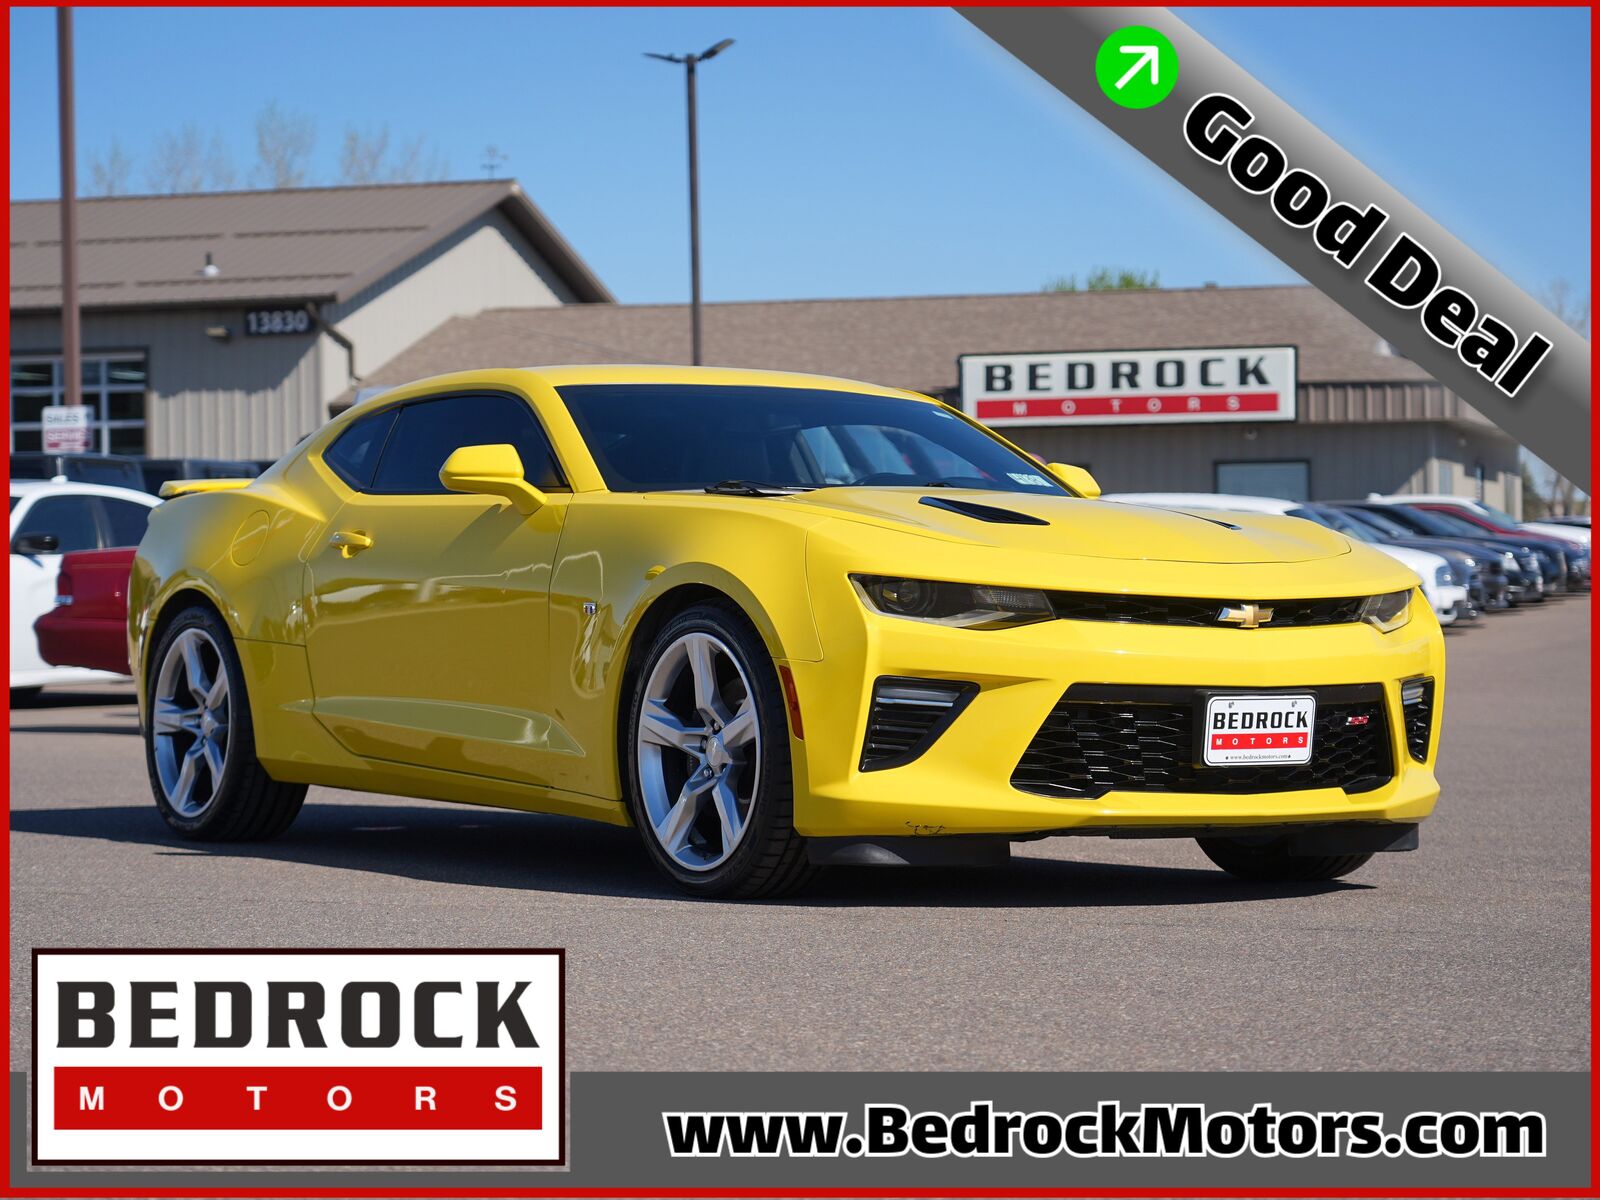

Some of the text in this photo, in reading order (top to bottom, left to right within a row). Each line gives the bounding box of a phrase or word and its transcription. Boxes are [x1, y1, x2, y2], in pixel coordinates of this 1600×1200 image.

[247, 310, 308, 334] 13830
[984, 356, 1271, 393] BEDROCK
[1013, 396, 1240, 417] MOTORS
[1213, 710, 1309, 730] BEDROCK
[1215, 736, 1304, 746] MOTORS
